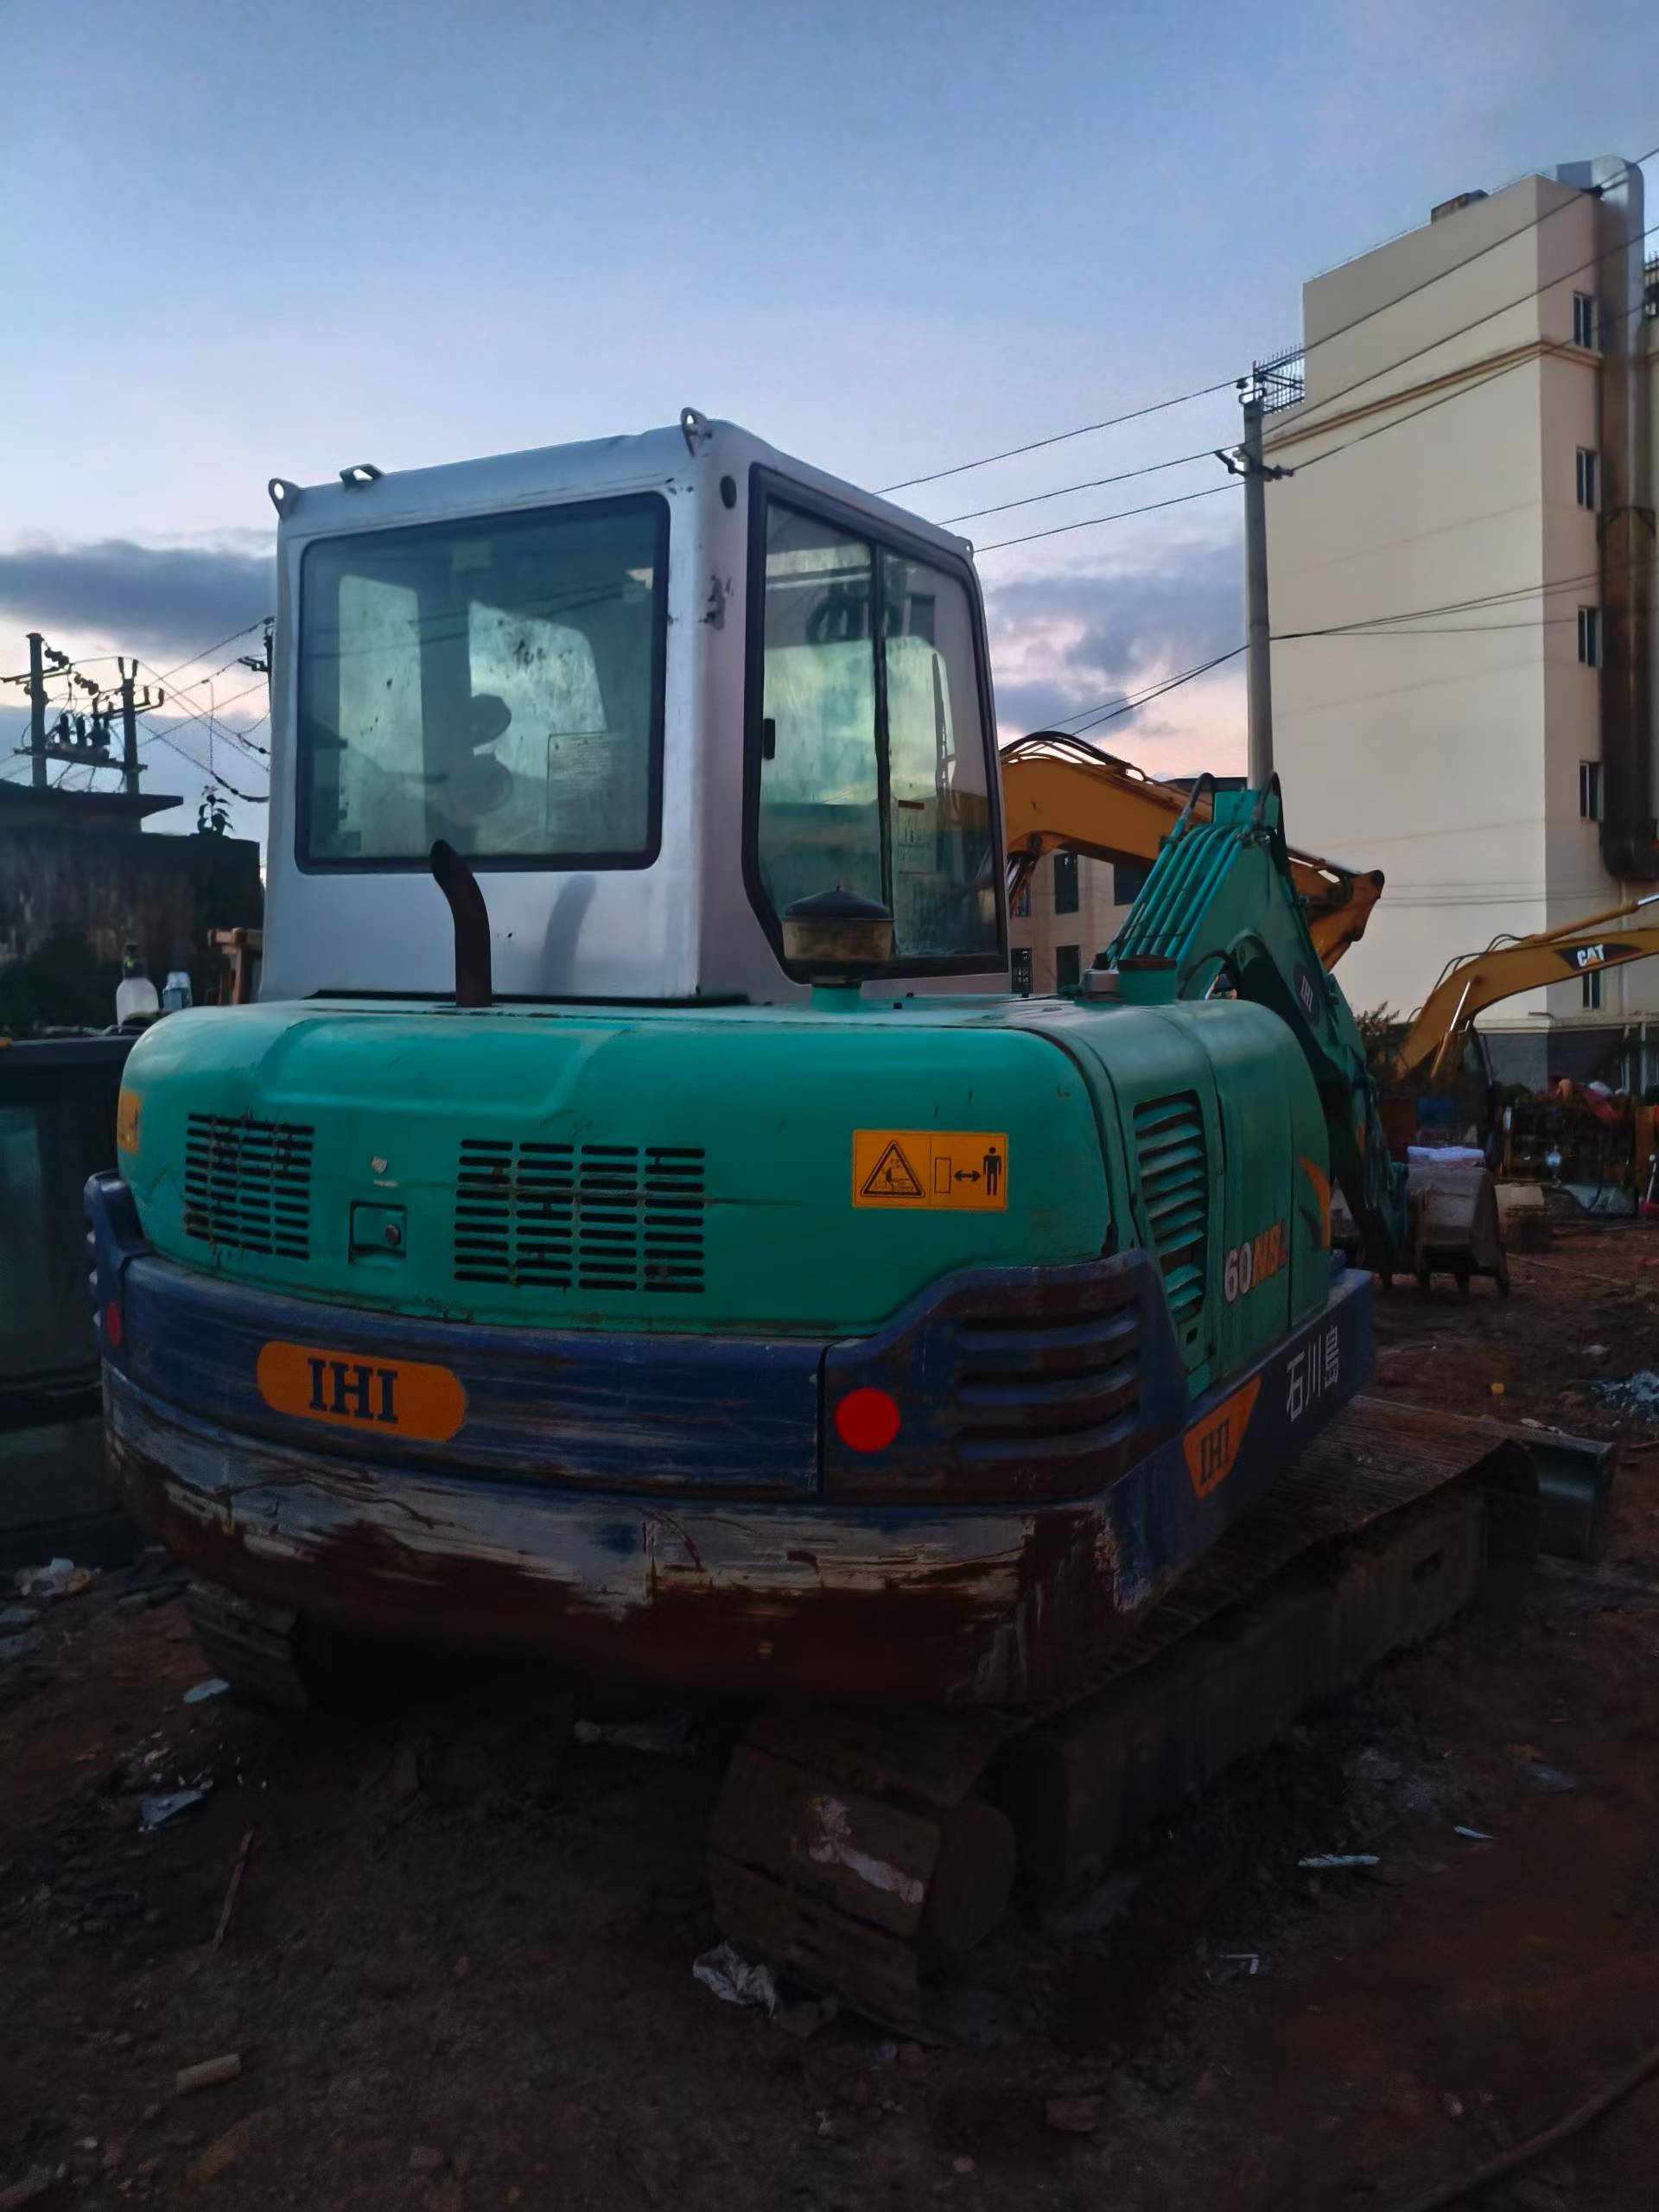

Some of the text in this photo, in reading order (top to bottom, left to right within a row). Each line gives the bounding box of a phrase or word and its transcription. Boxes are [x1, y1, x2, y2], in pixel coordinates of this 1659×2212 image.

[1576, 944, 1605, 968] CAT
[308, 1357, 399, 1425] IHI
[1286, 1325, 1339, 1422] 石川島
[1200, 1420, 1230, 1484] IHI
